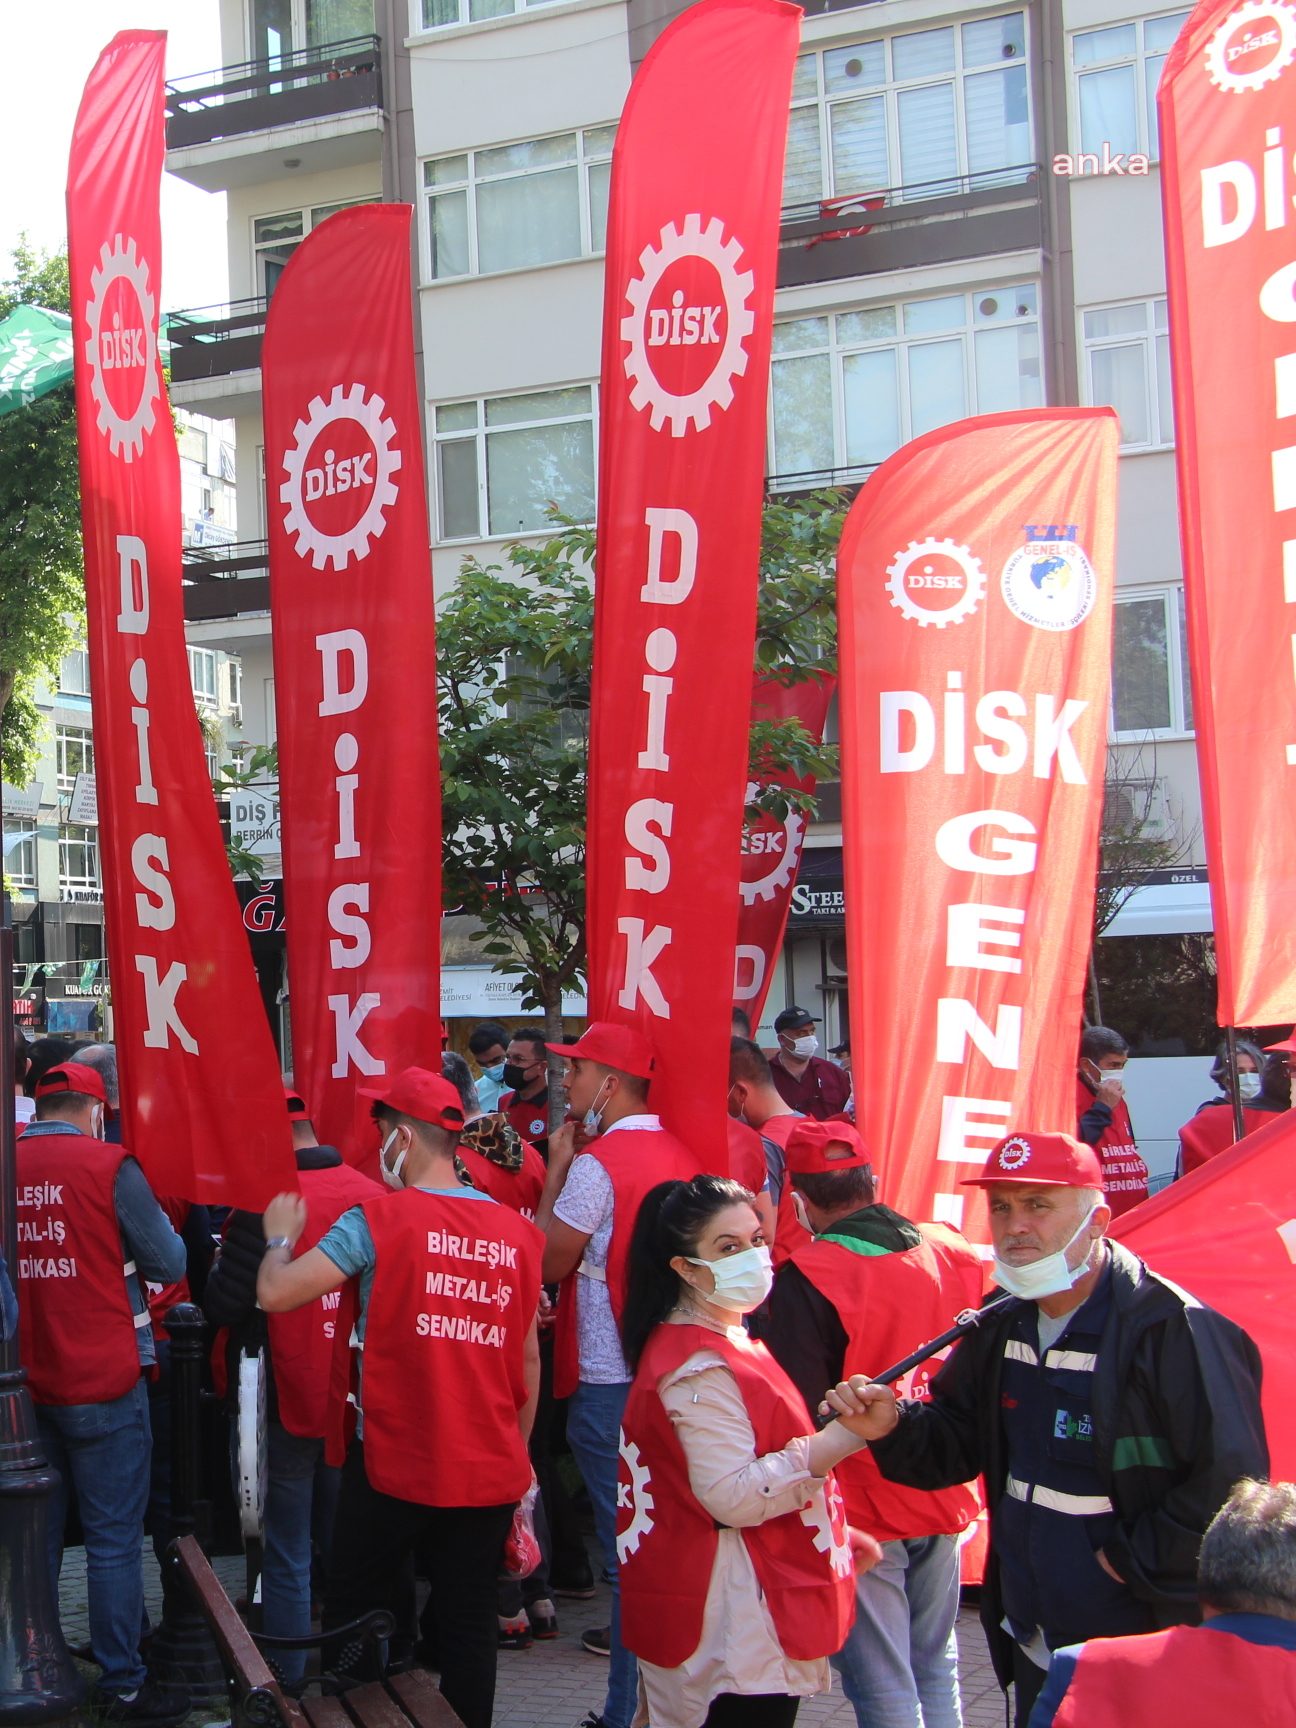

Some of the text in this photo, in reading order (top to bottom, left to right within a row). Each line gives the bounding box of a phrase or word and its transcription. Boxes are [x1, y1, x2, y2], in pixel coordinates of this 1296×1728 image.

[1227, 29, 1280, 61] DİSK
[1201, 127, 1296, 248] Dİ
[648, 289, 721, 346] DİSK
[101, 311, 145, 369] DİSK
[305, 449, 373, 502] DİSK
[1023, 544, 1077, 560] GENEL-İŞ
[908, 565, 963, 589] DİSK
[1004, 554, 1023, 585] TÜRKİYE
[1005, 587, 1020, 612] GENEL
[1020, 610, 1065, 628] HİZMETLER
[879, 671, 1090, 784] DİSK
[618, 507, 698, 1020] DİSK
[116, 535, 200, 1056] DİSK
[1133, 784, 1160, 792] SIGA
[235, 800, 266, 825] DİŞ
[315, 628, 385, 1079] DİSK
[741, 823, 783, 855] İSK
[1171, 874, 1199, 883] ÖZEL
[789, 885, 844, 915] STEE
[440, 993, 471, 1001] ELEDİYESİ
[485, 982, 506, 991] AFİYET
[1004, 1148, 1022, 1158] DİSK
[1101, 1144, 1137, 1157] BİRLE
[17, 1180, 63, 1210] LEŞİK
[1102, 1177, 1148, 1192] SENDİKAS
[17, 1216, 66, 1245] TAL-İŞ
[427, 1228, 517, 1270] BİRLEŞİK
[17, 1254, 77, 1279] DİKASI
[425, 1271, 513, 1312] METAL-İŞ
[416, 1313, 506, 1349] SENDİKAS
[912, 1371, 929, 1399] Dİ
